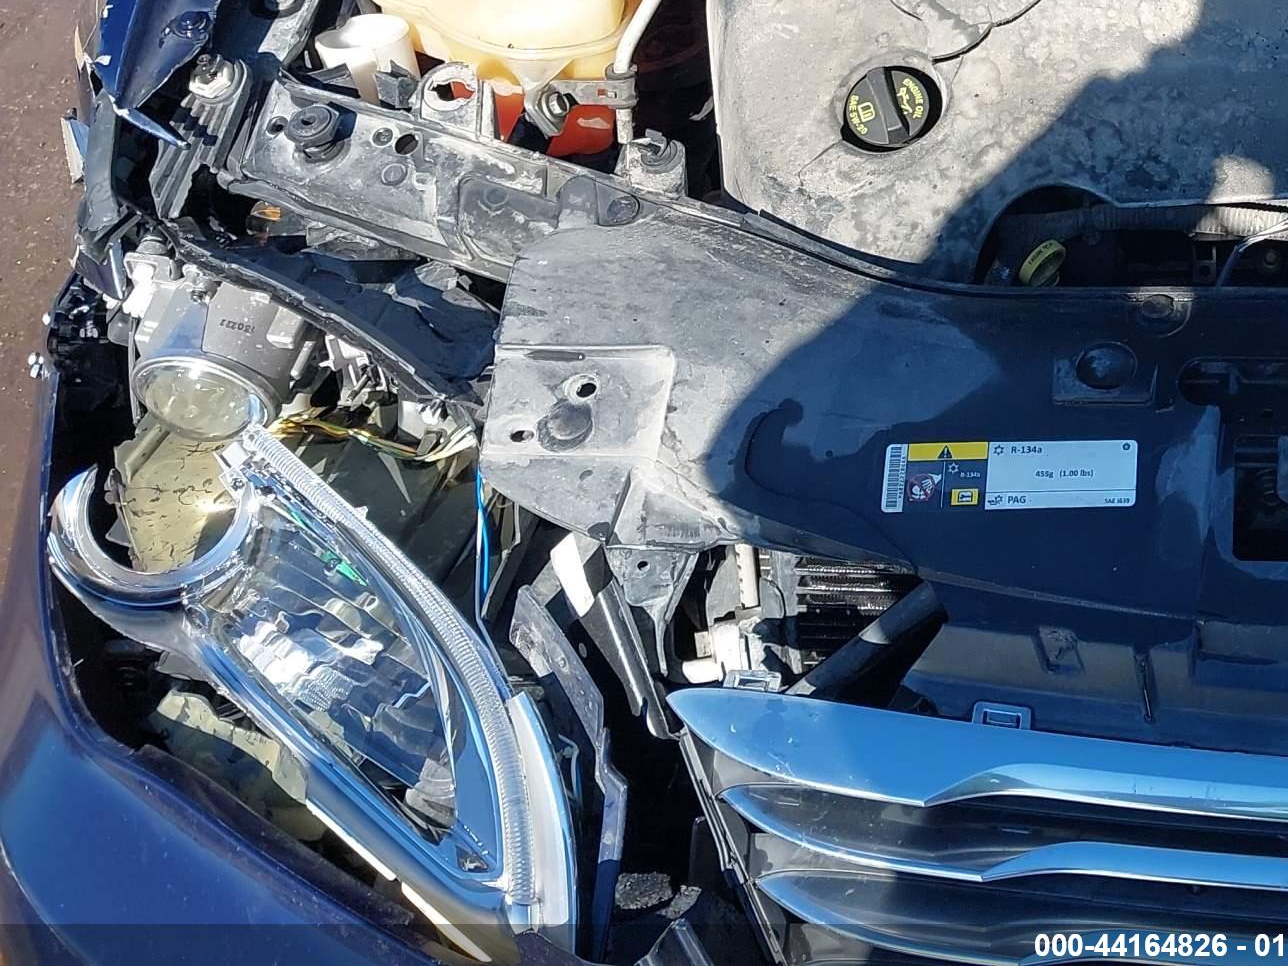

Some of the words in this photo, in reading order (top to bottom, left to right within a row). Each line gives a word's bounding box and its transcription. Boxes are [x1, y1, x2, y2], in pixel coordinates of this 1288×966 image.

[848, 94, 859, 111] SAE
[902, 78, 924, 105] ENGINE
[913, 105, 924, 119] OIL
[1010, 445, 1043, 454] R-134a
[1035, 470, 1054, 479] 455g
[1059, 469, 1079, 479] (1.00
[1080, 469, 1094, 478] lbs)
[1007, 495, 1027, 504] PAG
